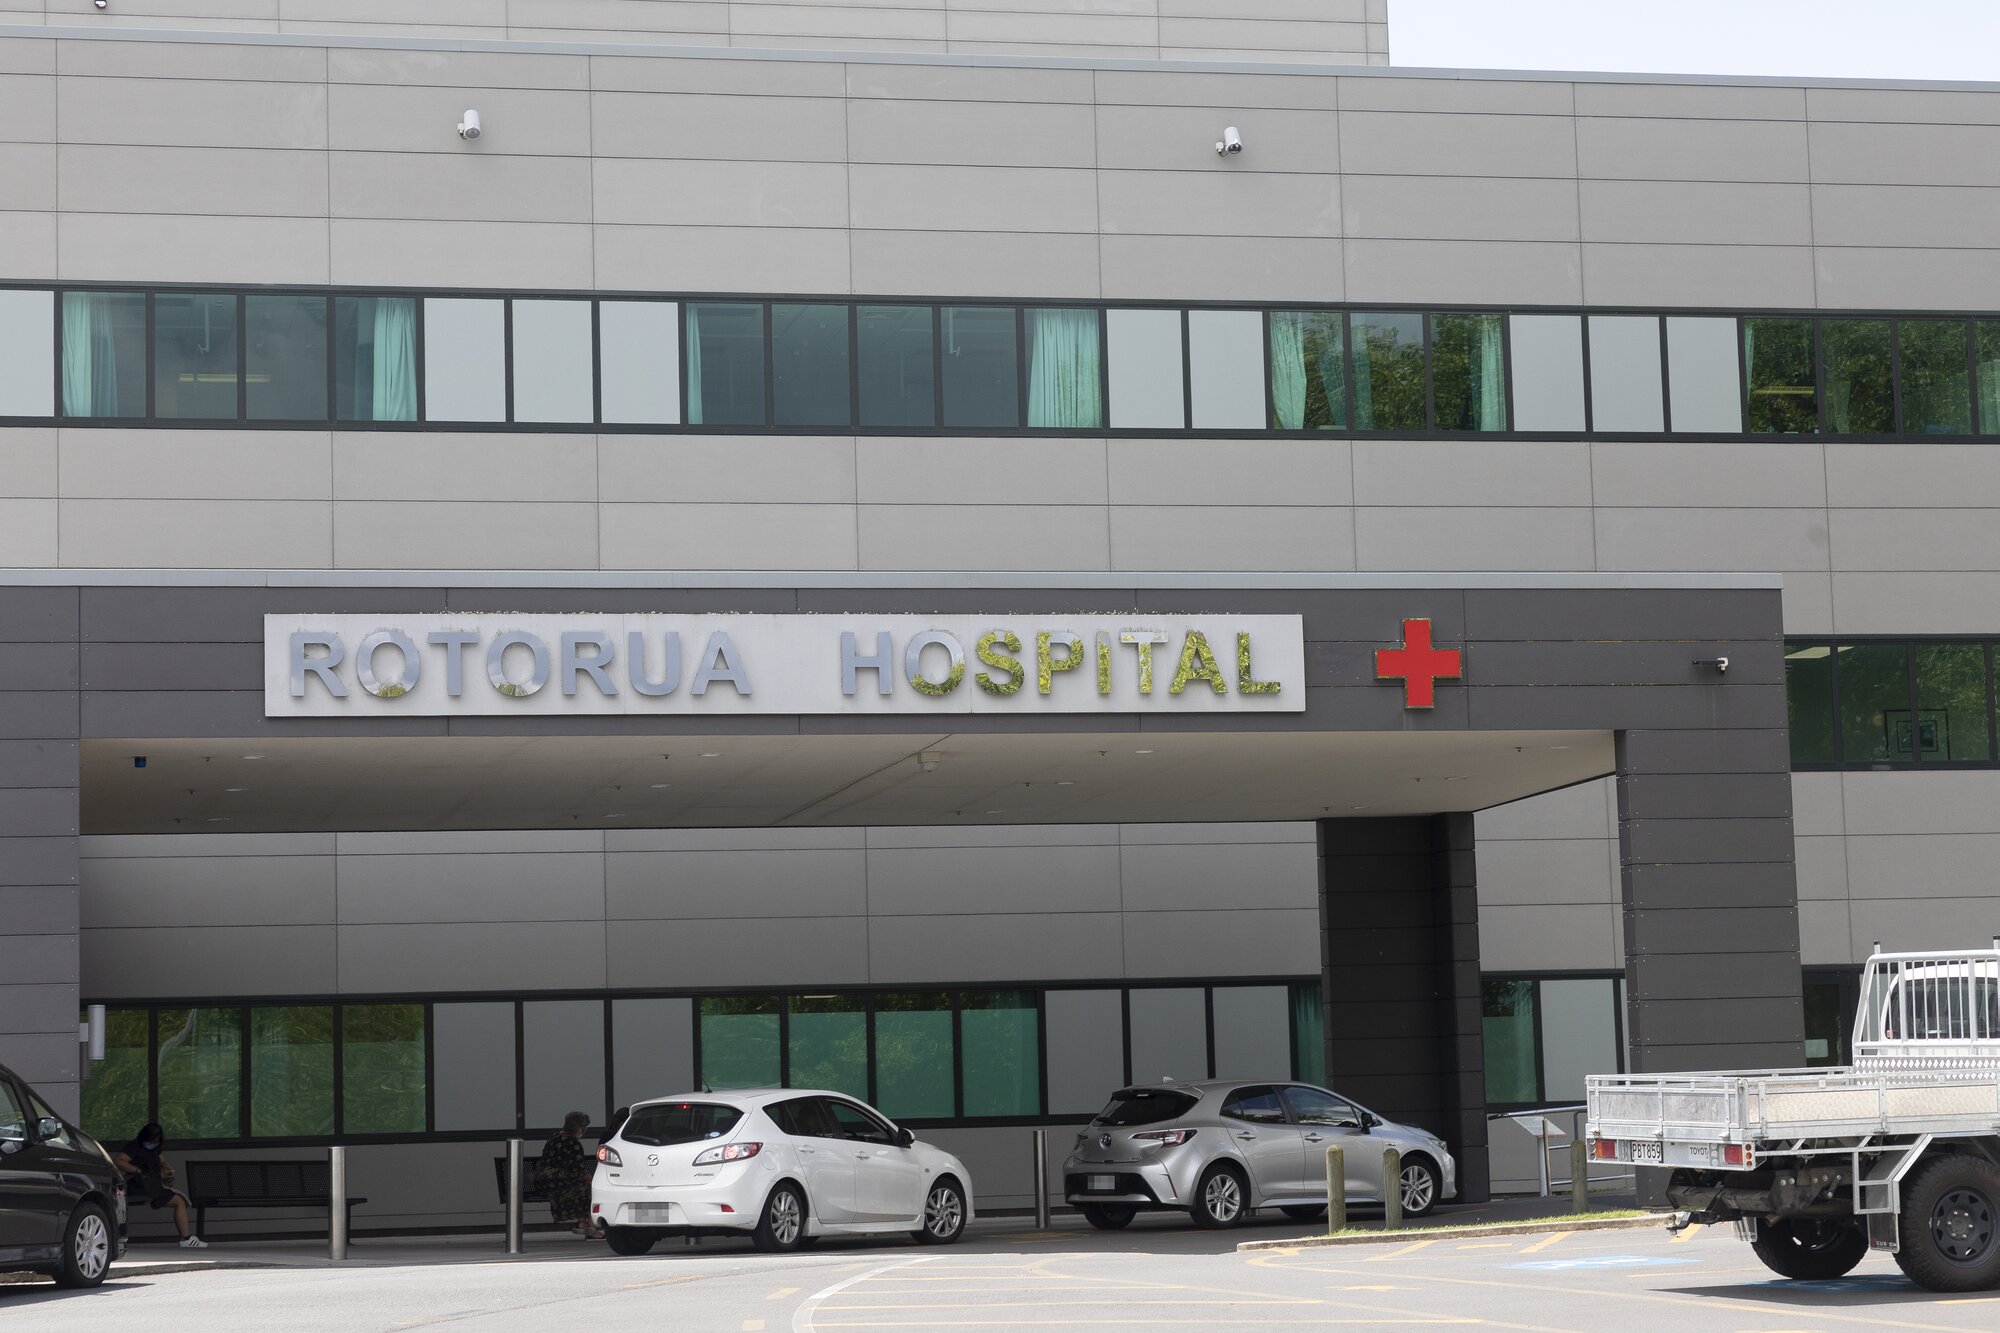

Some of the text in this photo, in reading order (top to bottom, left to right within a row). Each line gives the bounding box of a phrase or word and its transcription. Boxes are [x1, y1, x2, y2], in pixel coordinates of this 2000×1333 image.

[290, 631, 1282, 697] ROTORUA HOSPITAL
[1632, 1143, 1661, 1159] PBT859
